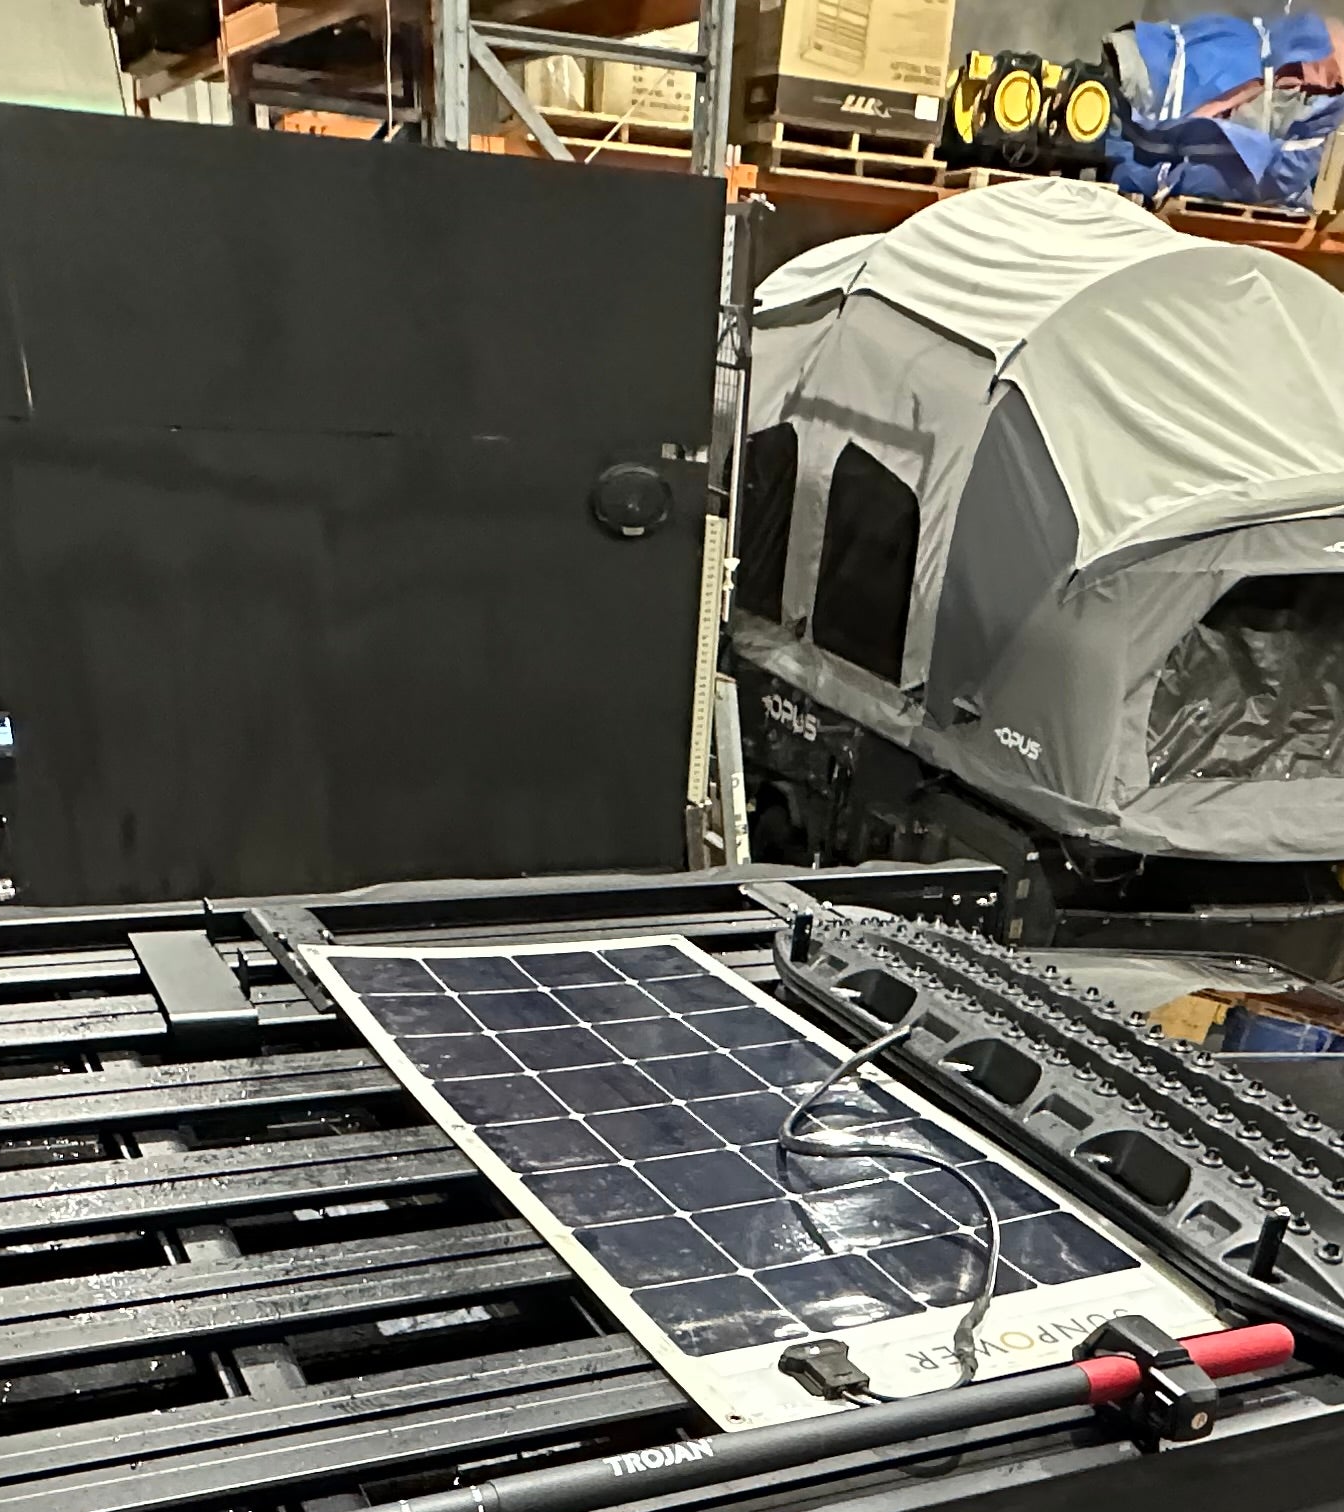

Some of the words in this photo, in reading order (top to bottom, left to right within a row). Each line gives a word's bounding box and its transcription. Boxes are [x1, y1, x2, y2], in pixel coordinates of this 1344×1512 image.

[764, 693, 818, 742] OPUS
[997, 726, 1042, 761] OPUS
[602, 1438, 714, 1477] TROJAN
